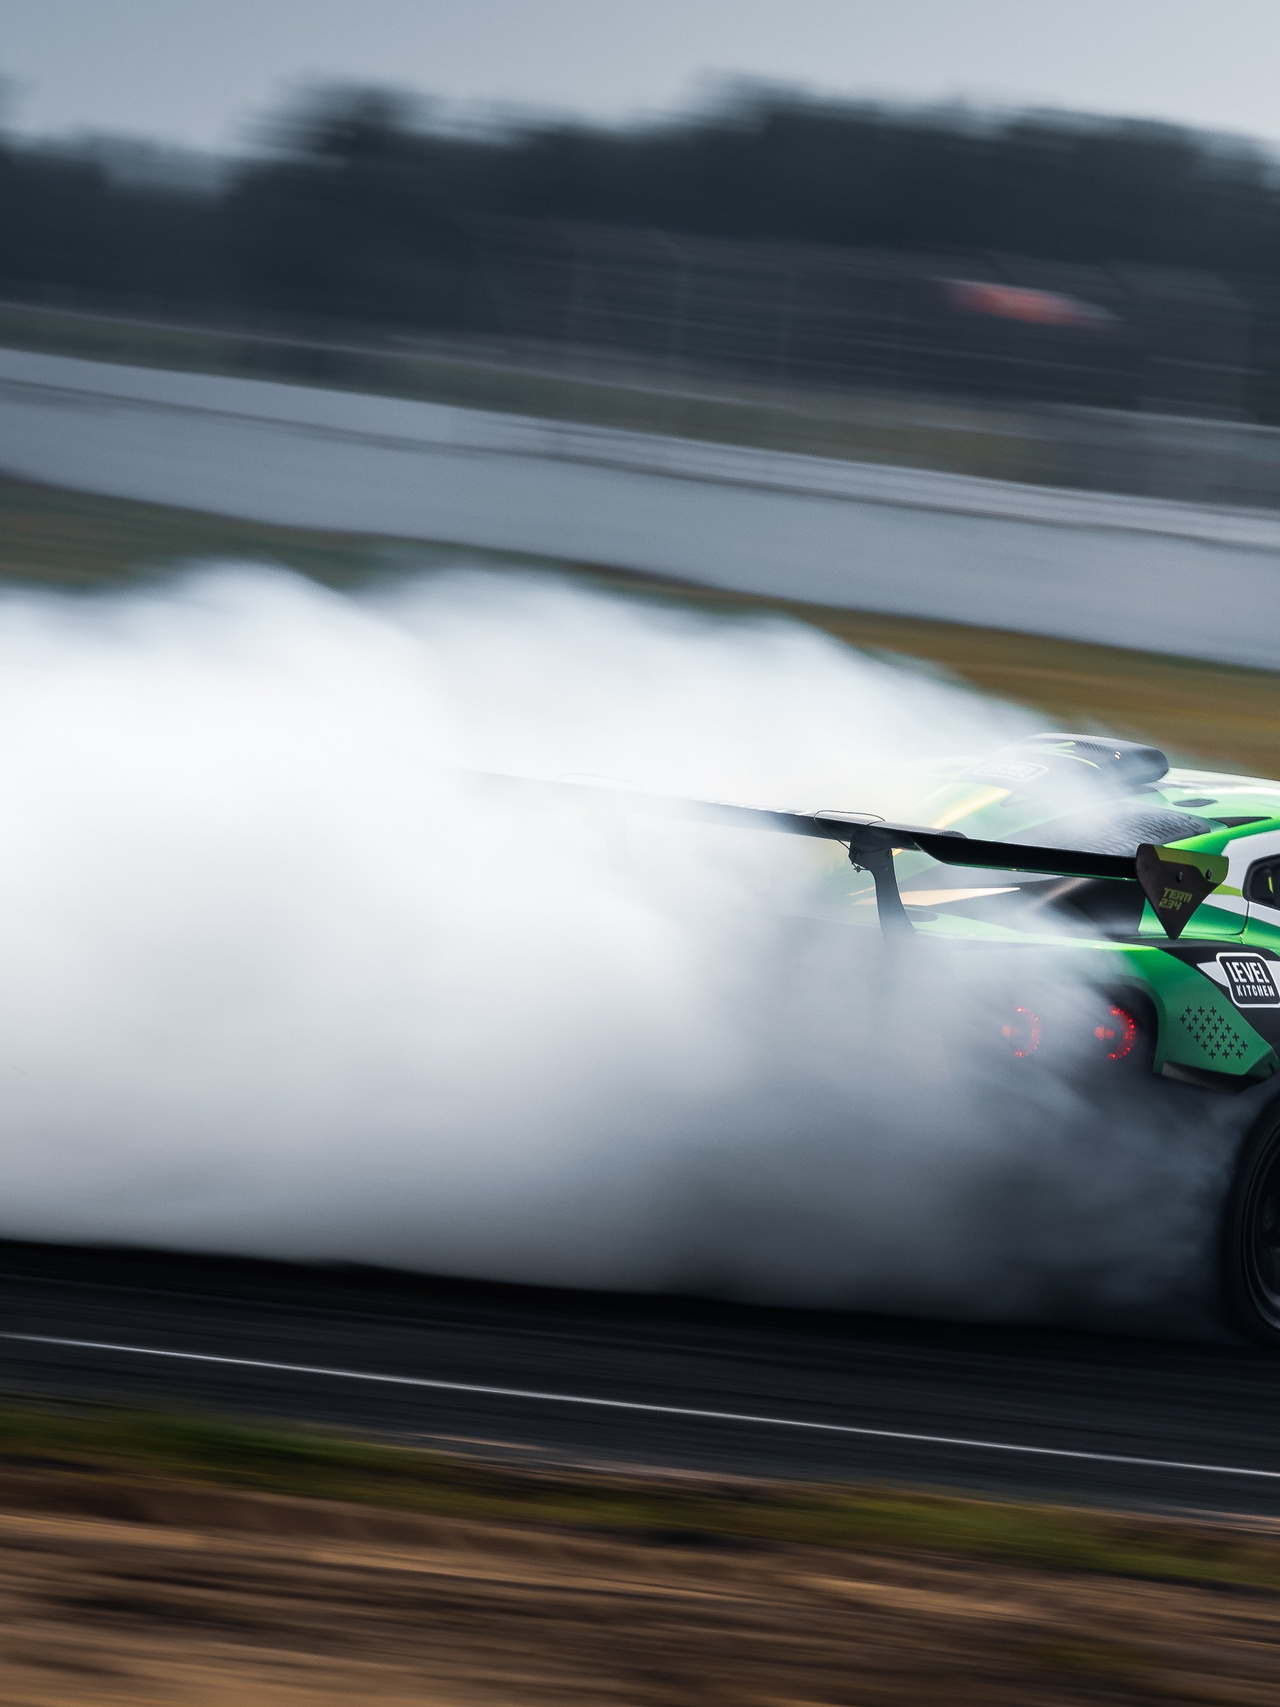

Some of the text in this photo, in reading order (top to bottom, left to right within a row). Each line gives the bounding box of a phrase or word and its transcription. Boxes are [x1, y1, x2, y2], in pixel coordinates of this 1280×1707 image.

[1163, 887, 1193, 903] TEAM
[1226, 961, 1270, 984] LEVEL
[1236, 984, 1275, 997] KITCHEN
